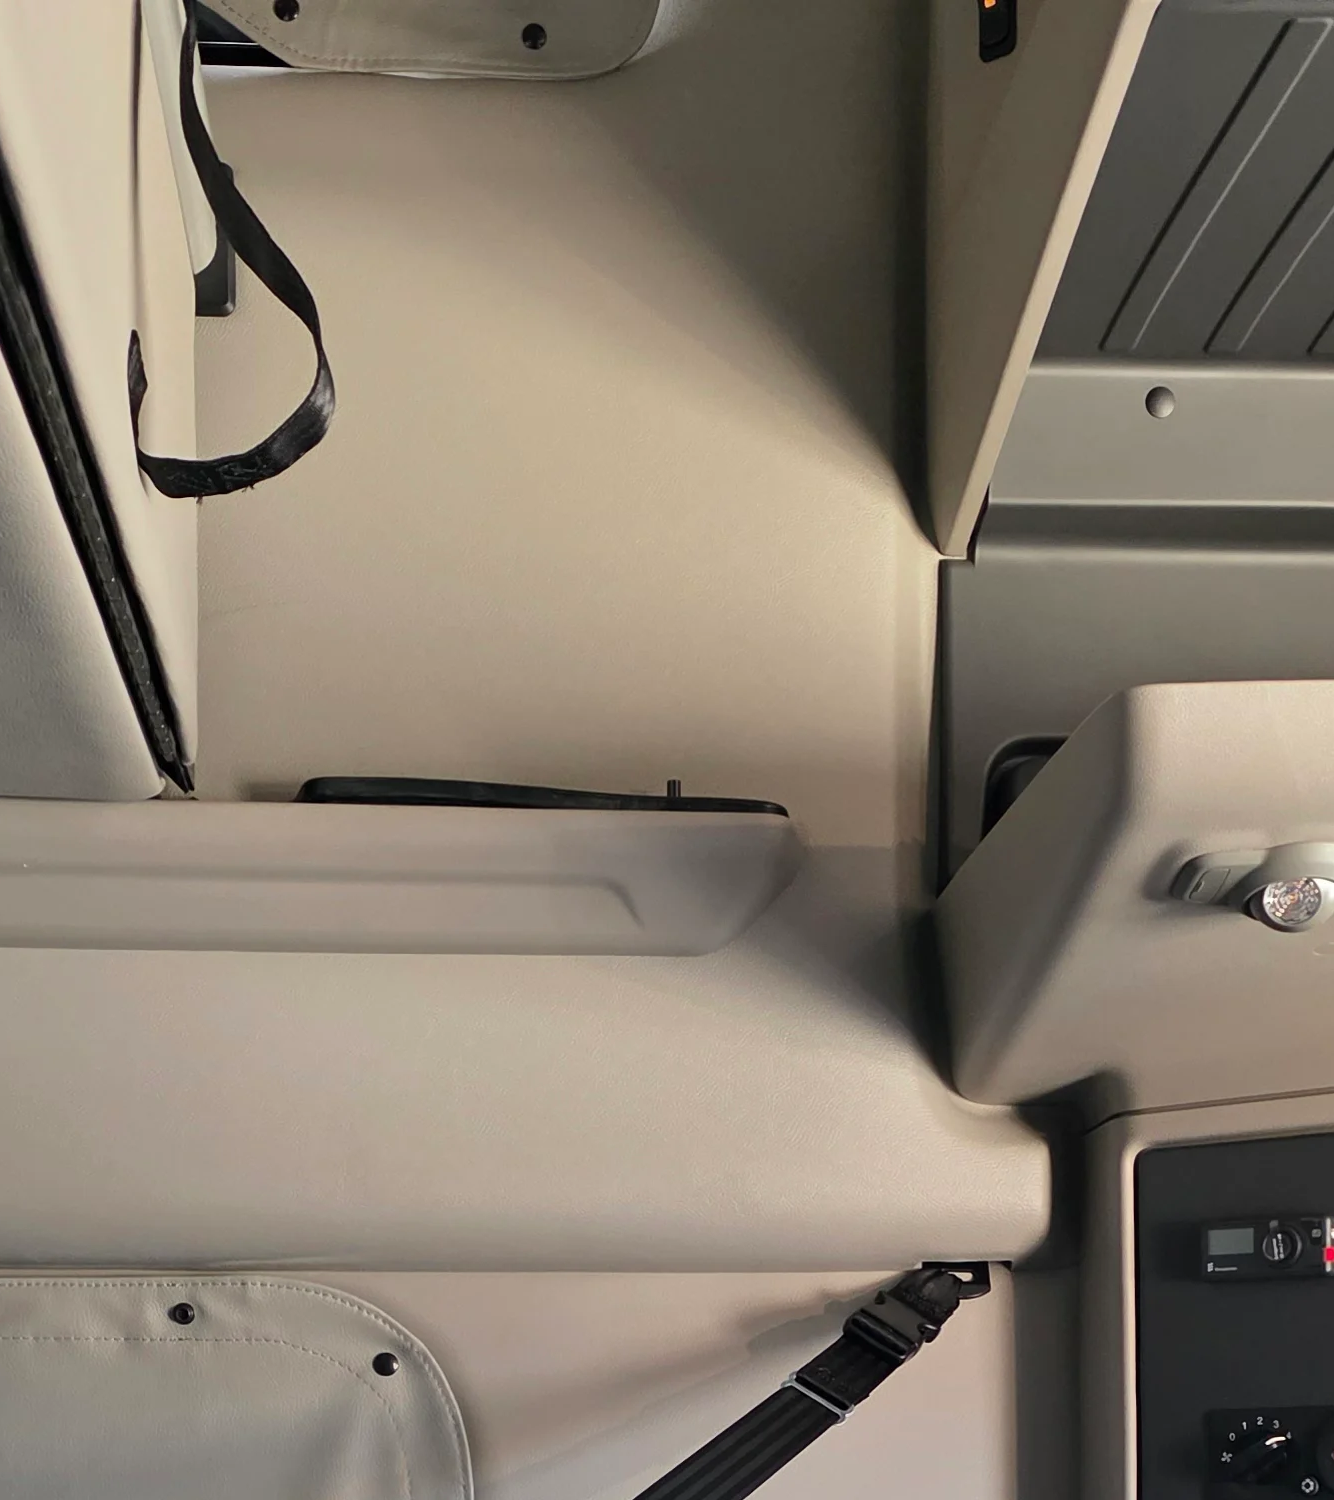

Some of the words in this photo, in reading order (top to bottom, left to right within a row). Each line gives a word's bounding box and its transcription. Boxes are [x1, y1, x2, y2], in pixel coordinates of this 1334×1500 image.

[1228, 1432, 1236, 1441] 0
[1241, 1421, 1247, 1431] 1
[1256, 1416, 1264, 1426] 2
[1272, 1419, 1280, 1429] 3
